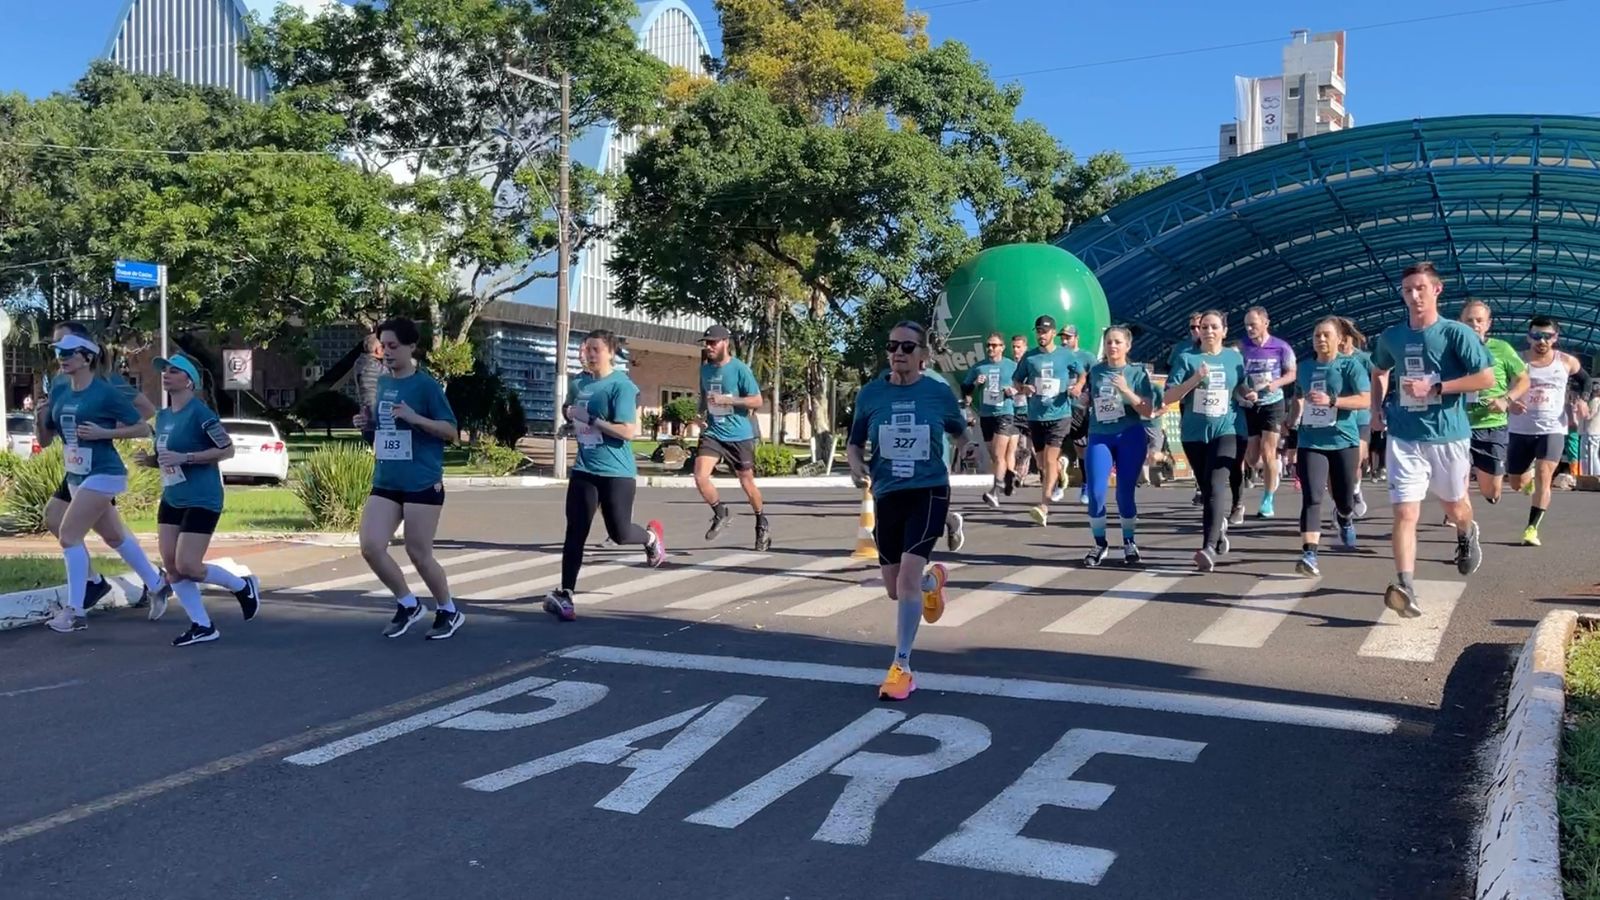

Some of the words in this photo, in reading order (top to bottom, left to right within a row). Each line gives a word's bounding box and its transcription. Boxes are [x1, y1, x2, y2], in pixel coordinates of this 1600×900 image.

[939, 342, 986, 372] med
[1202, 398, 1220, 406] 292
[1099, 404, 1116, 413] 265
[1310, 408, 1328, 416] 325
[384, 440, 401, 450] 183
[893, 437, 918, 449] 327
[282, 676, 1208, 885] PARE
